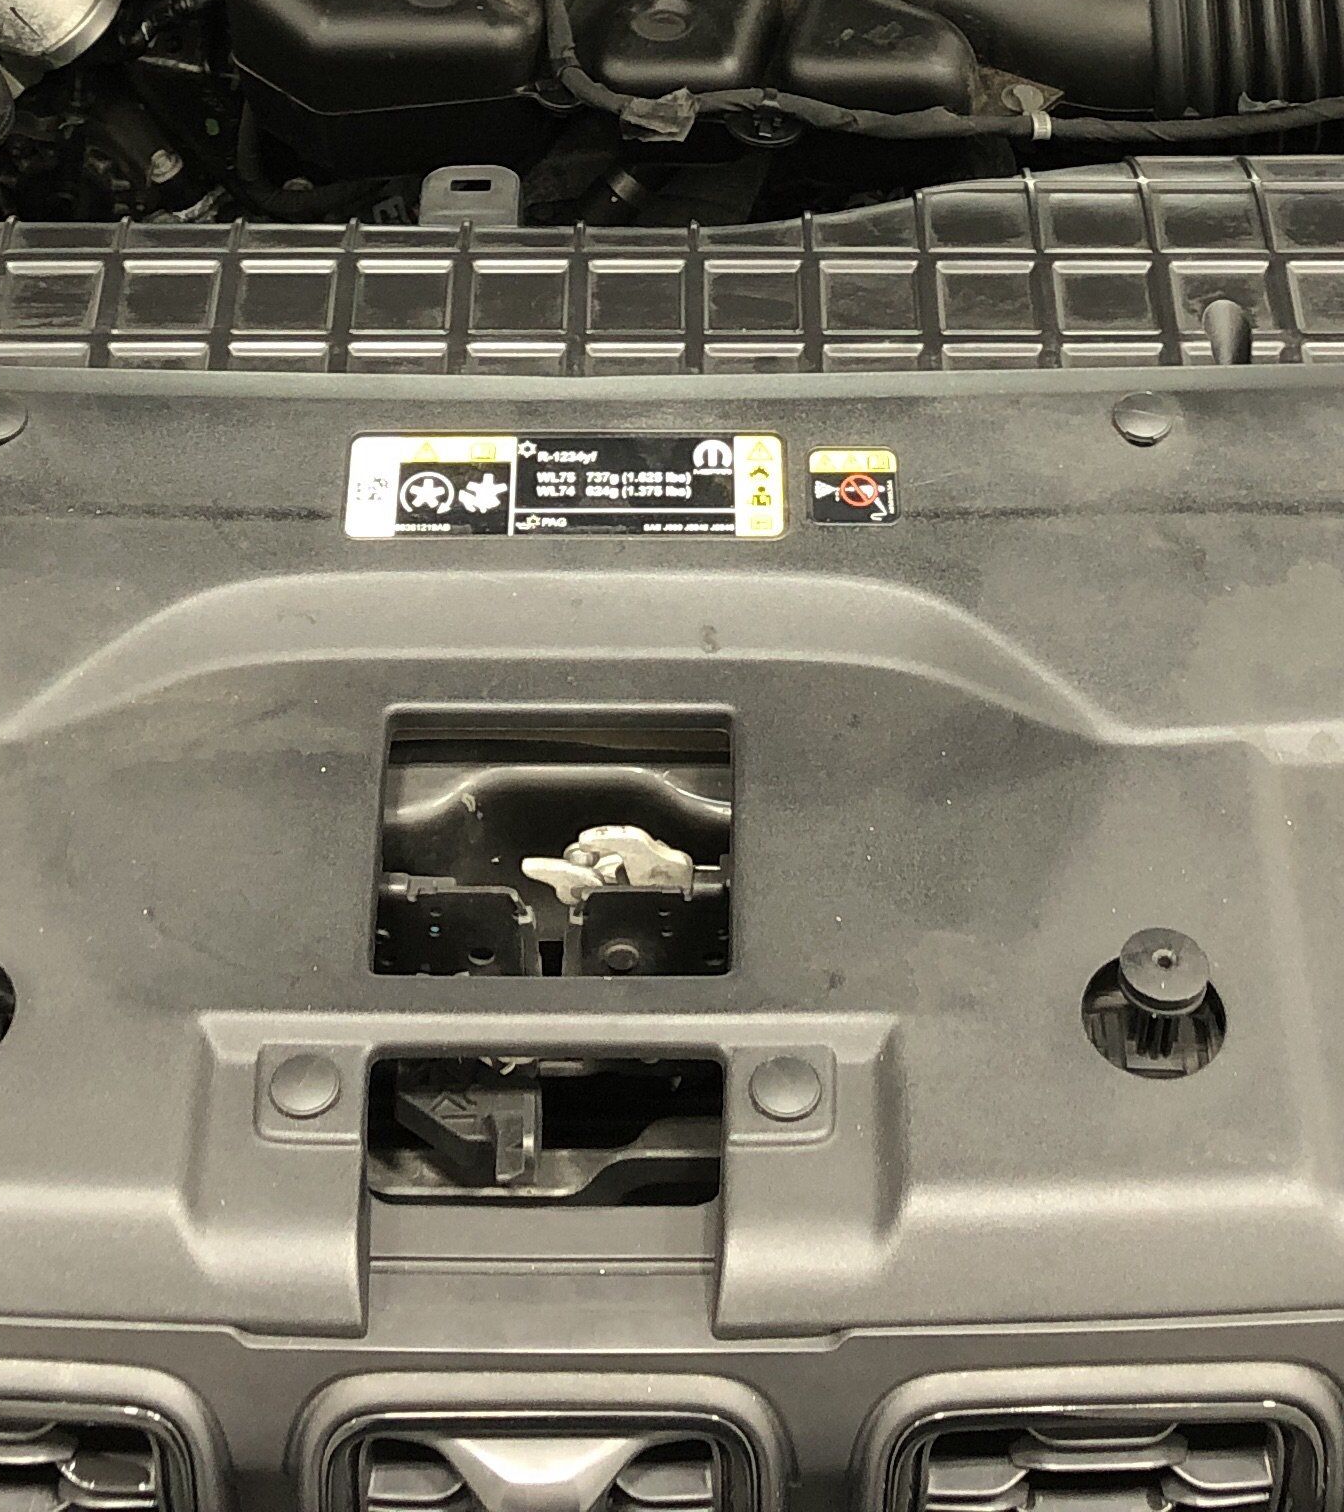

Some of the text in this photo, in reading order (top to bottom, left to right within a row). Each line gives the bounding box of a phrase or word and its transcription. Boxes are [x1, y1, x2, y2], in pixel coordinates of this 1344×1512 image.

[537, 450, 598, 465] R-1234yf
[536, 471, 577, 484] WL75
[585, 471, 620, 486] 737g
[536, 485, 577, 497] WL74
[541, 517, 568, 528] PAG
